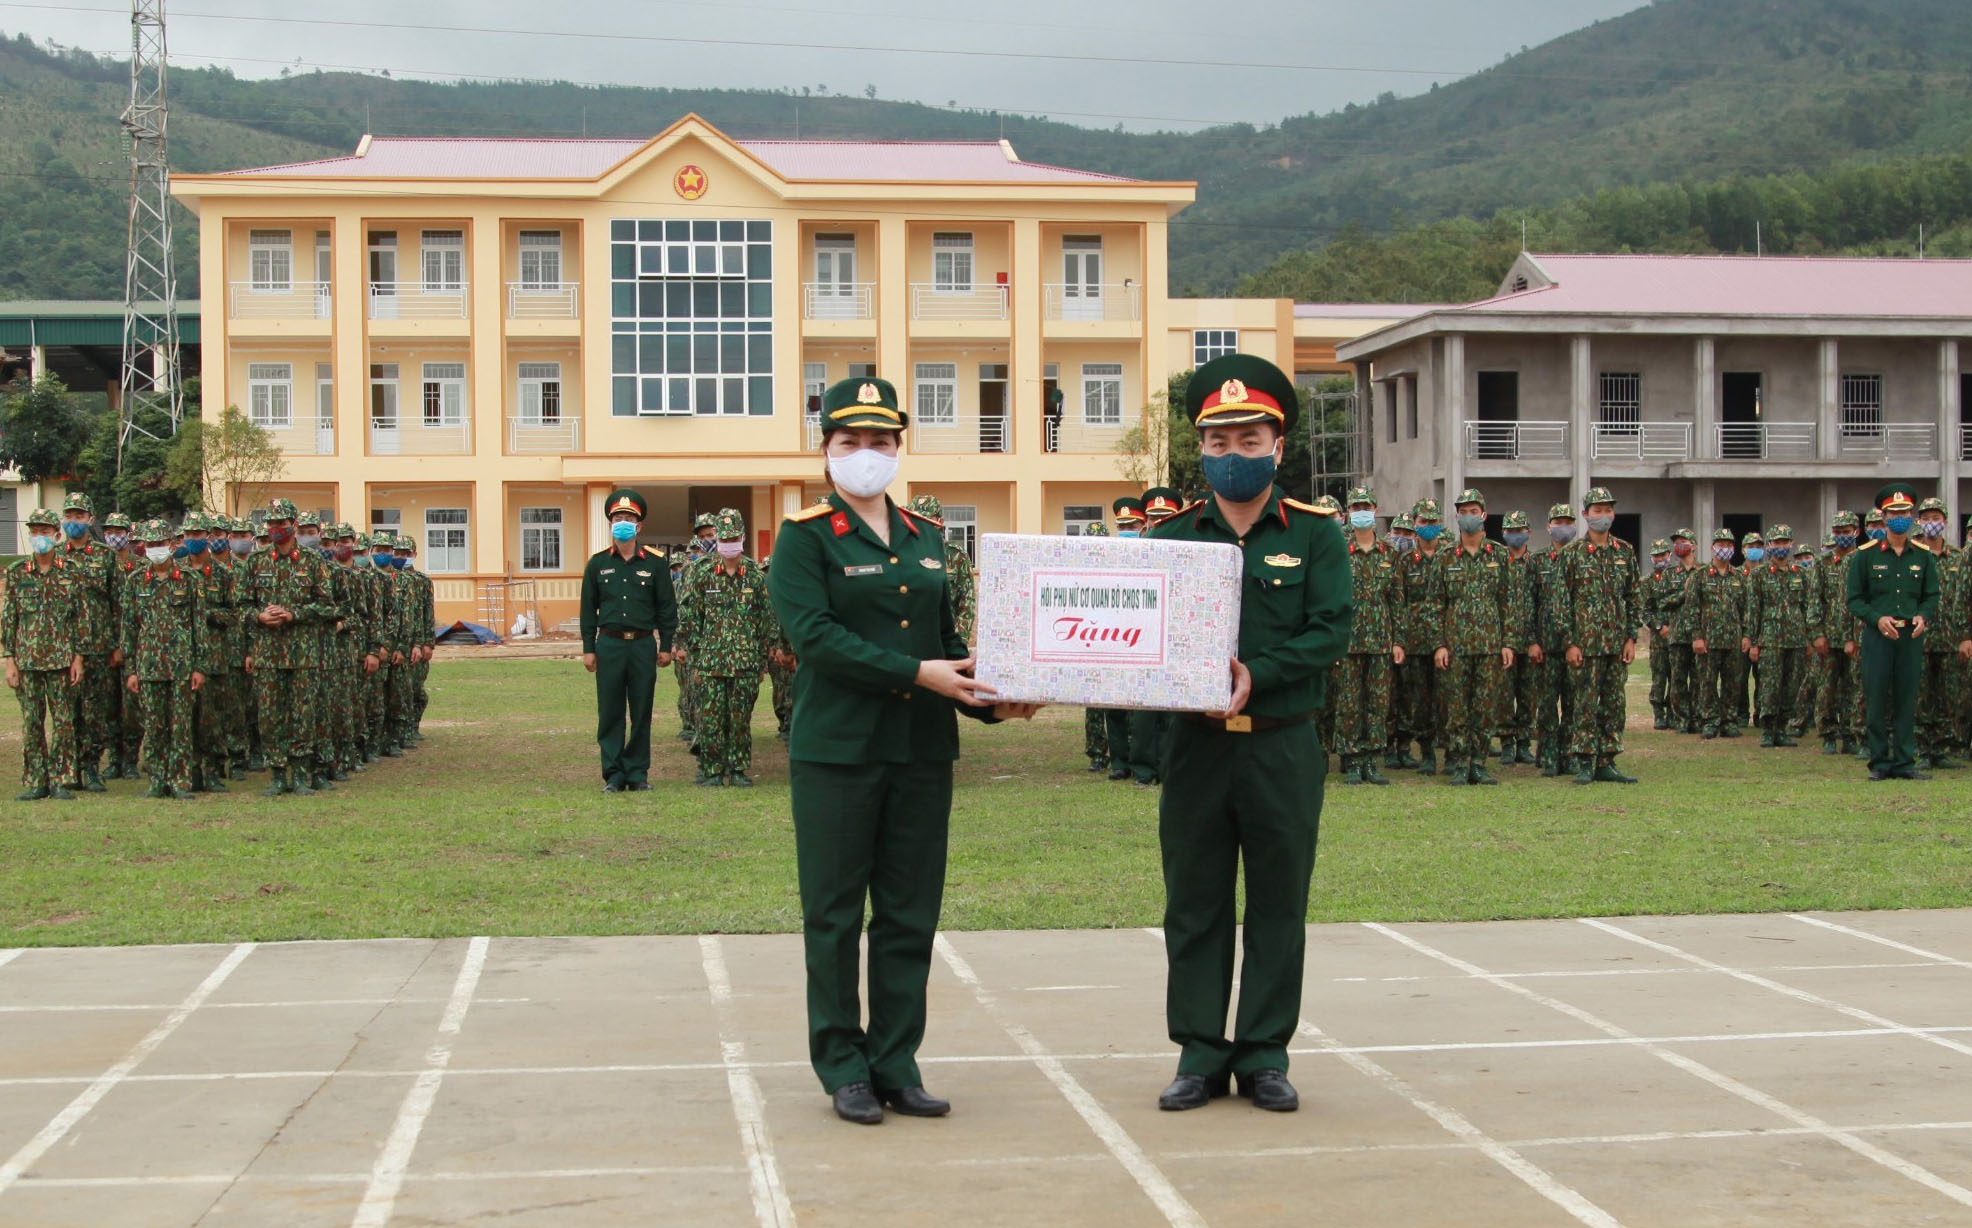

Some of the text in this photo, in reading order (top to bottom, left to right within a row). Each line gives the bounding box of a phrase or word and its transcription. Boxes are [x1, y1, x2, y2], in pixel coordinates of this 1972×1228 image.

[1054, 587, 1067, 612] PHỤ
[1080, 586, 1090, 608] CƠ
[1091, 587, 1110, 610] QUAN
[1053, 616, 1142, 648] Tặng
